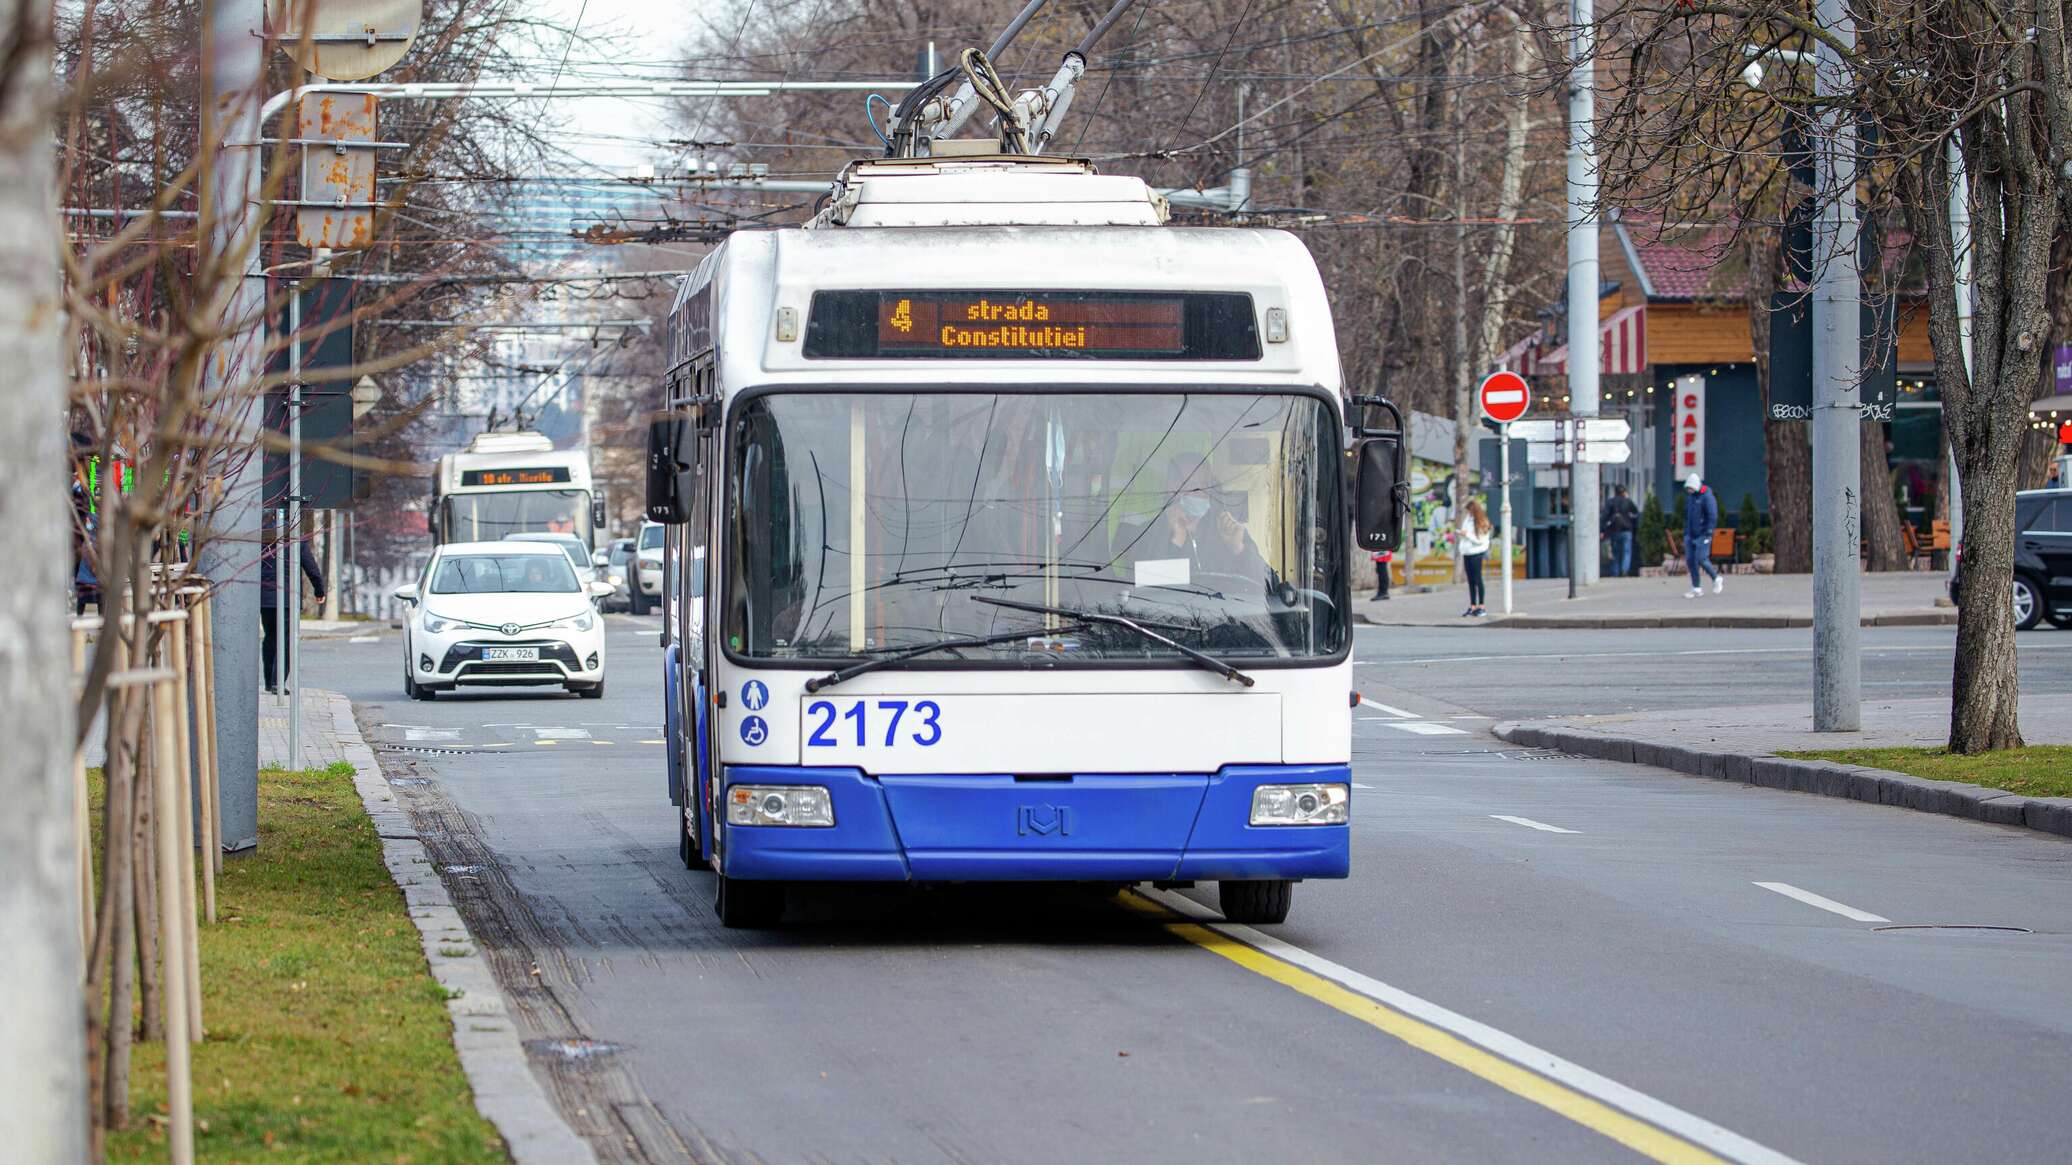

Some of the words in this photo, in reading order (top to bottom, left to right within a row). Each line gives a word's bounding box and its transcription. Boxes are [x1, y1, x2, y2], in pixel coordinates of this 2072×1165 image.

[891, 300, 912, 332] 4
[967, 300, 1049, 321] strada
[941, 326, 1086, 348] Constitutiei
[1683, 394, 1698, 467] CAFE
[652, 506, 669, 515] 173
[1370, 533, 1386, 541] 173
[491, 649, 509, 659] ZZK
[516, 649, 534, 659] 926
[807, 700, 942, 747] 2173
